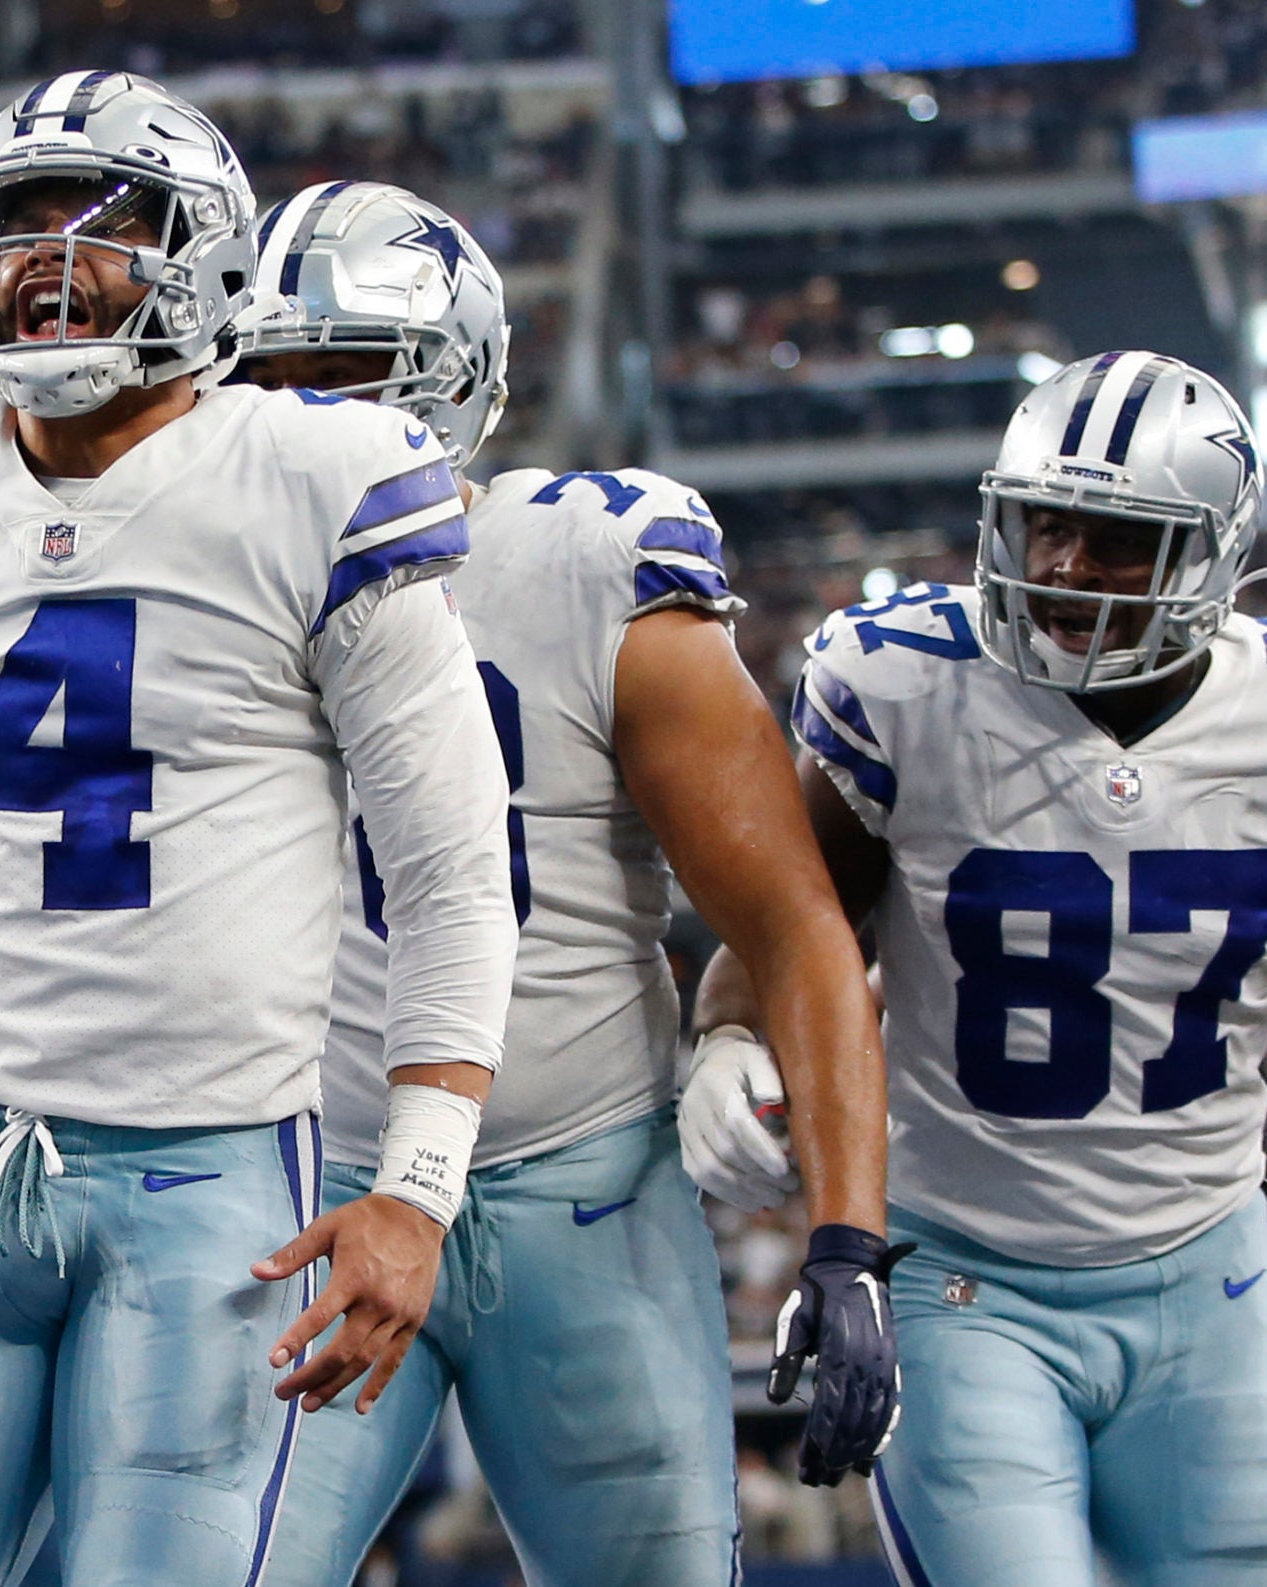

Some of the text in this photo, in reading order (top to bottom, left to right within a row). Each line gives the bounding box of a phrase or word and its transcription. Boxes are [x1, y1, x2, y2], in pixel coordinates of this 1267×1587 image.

[1060, 464, 1114, 482] COWBOYS
[45, 537, 72, 557] NFL
[943, 847, 1267, 1120] 87
